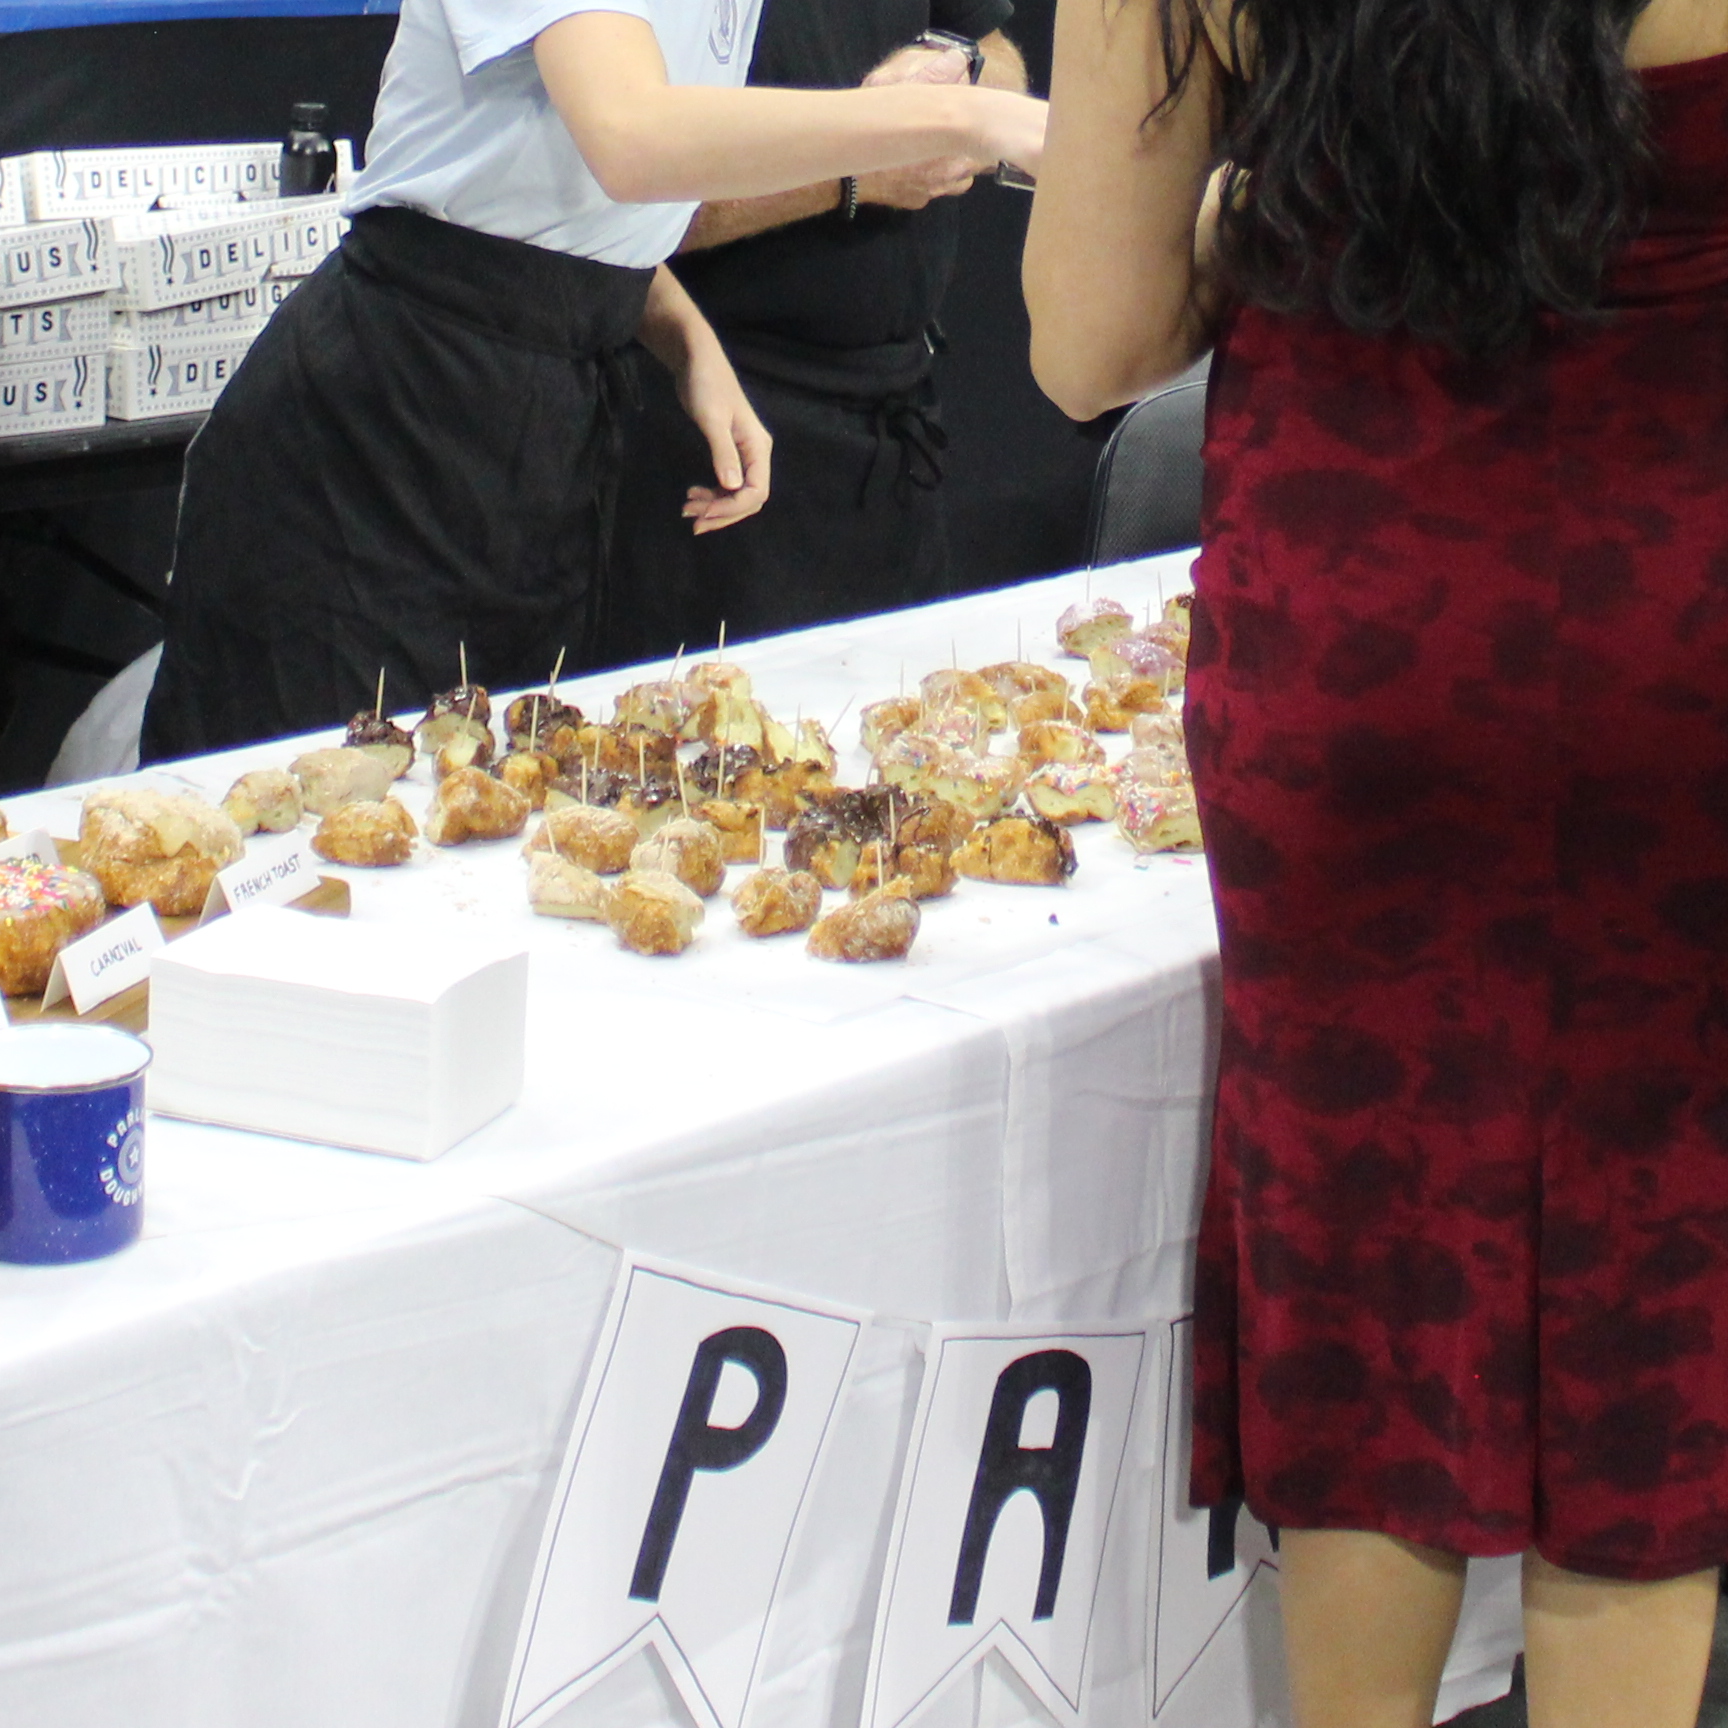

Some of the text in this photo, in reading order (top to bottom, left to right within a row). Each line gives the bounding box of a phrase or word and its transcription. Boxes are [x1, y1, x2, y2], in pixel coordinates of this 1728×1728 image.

[232, 853, 302, 904] FRENCH TOAST
[89, 937, 144, 977] CARNIVAL
